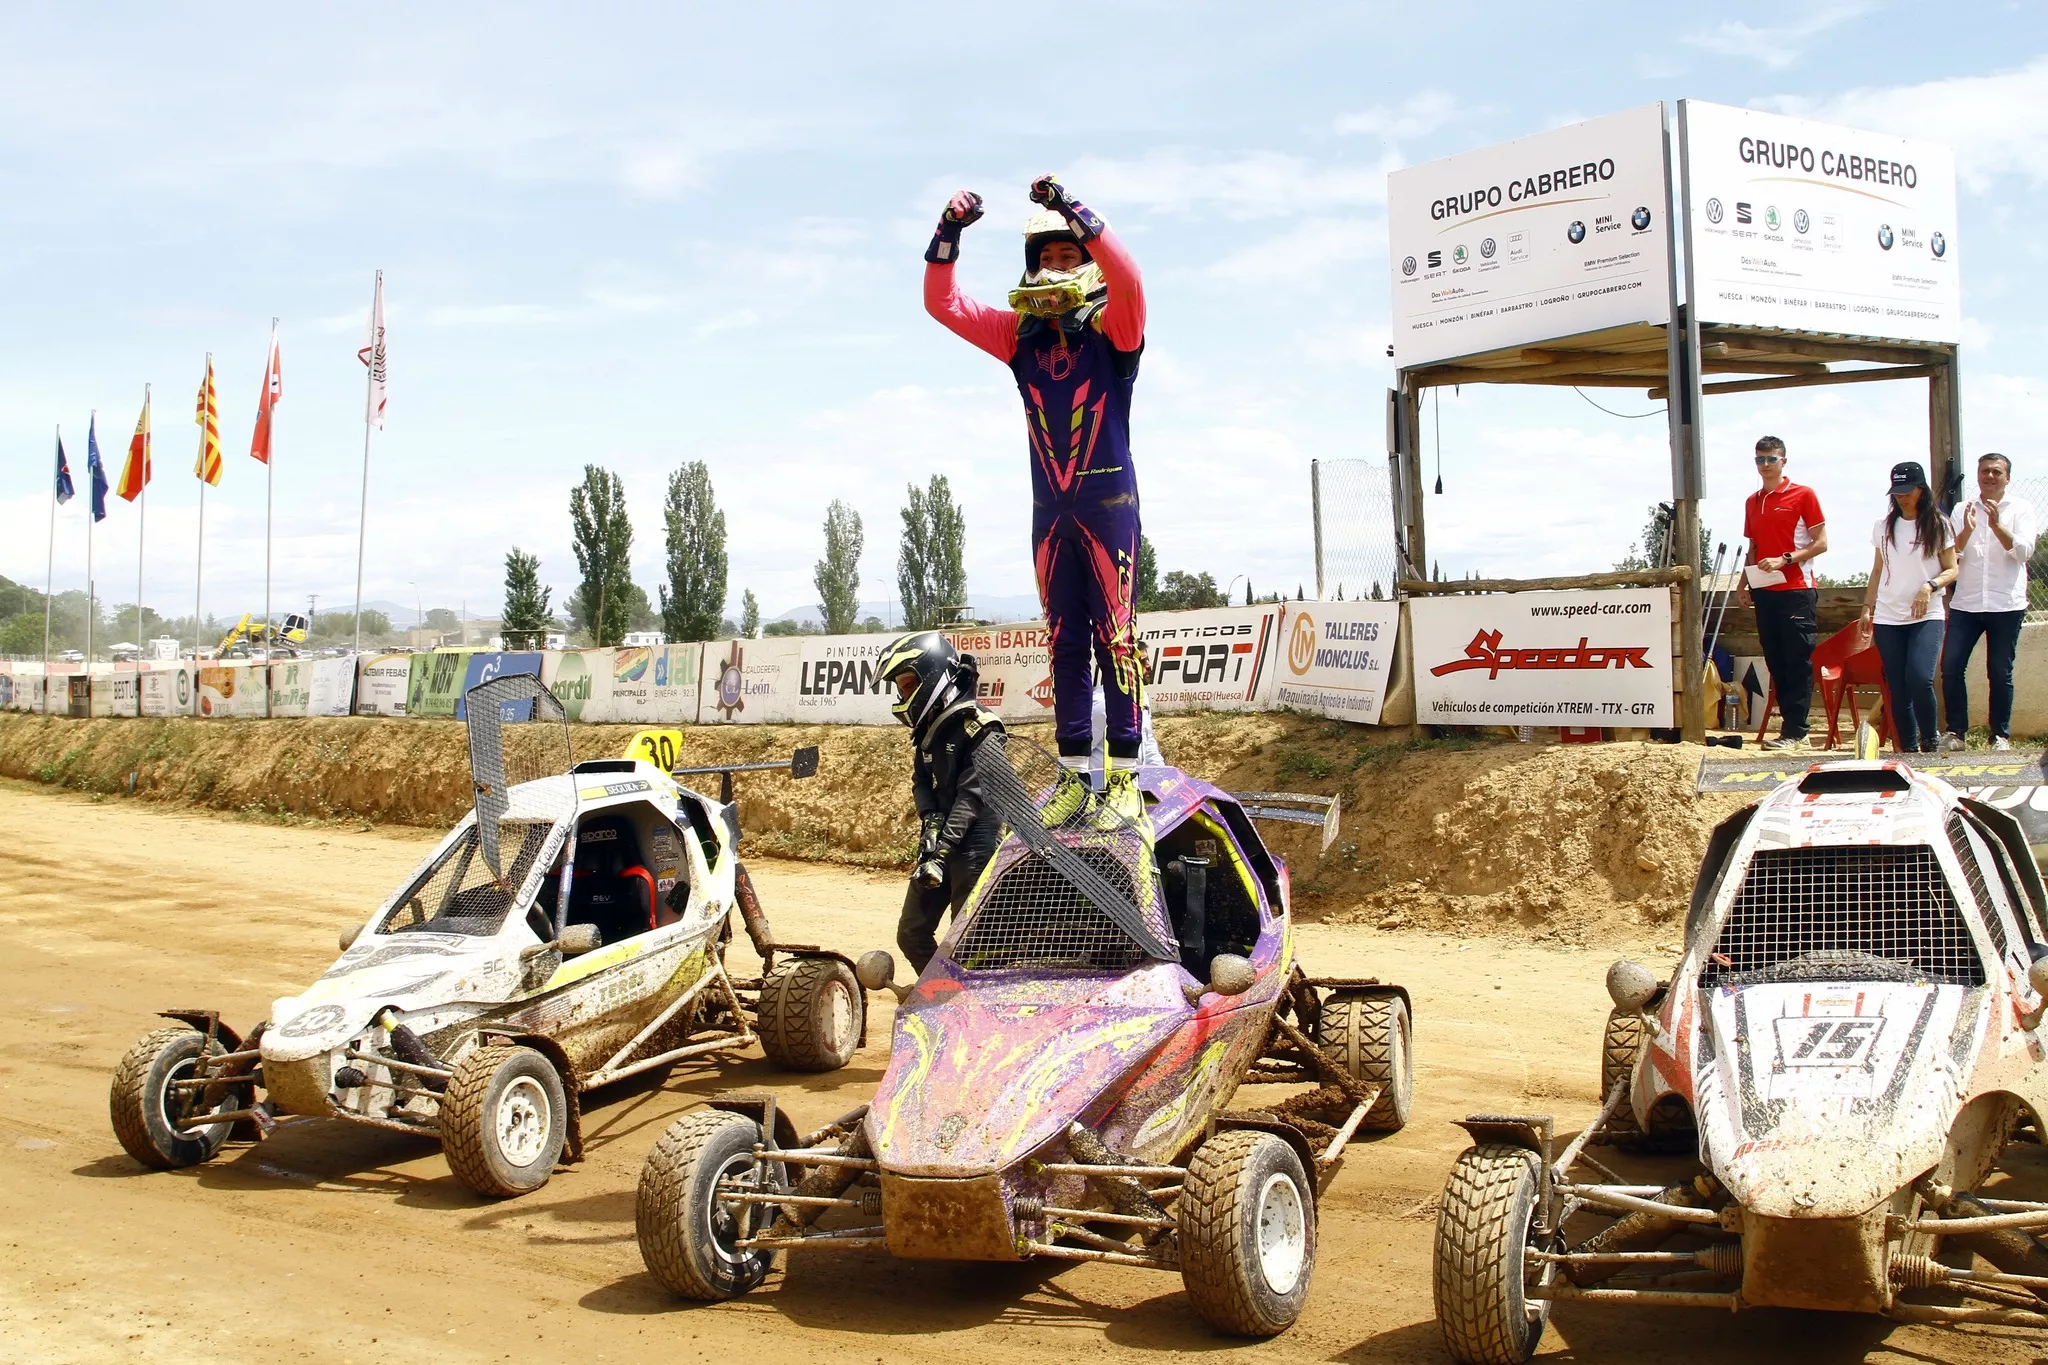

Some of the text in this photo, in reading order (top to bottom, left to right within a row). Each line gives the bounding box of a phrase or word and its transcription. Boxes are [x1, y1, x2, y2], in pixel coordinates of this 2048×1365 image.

[1739, 137, 1917, 189] GRUPO CABRERO
[1431, 158, 1615, 220] GRUPO CABRERO
[1595, 215, 1613, 225] MINI
[1595, 222, 1622, 234] Service
[1732, 229, 1759, 238] SEAT
[1901, 228, 1916, 238] MINI
[1901, 238, 1923, 249] Service
[1510, 248, 1523, 256] Audi
[1423, 270, 1448, 280] SEAT
[1412, 281, 1642, 330] HUESCA MONZÓN BINÉFAR BARBASTRO LOGROÑO GRUPOCABRERO.COM
[1719, 292, 1940, 320] HUESCA MONZÓN BINÉFAR BARBASTRO LOGROÑO GRUPOCABRERO.COM
[1531, 601, 1652, 618] www.speed-car.com
[1325, 622, 1379, 641] TALLERES
[942, 633, 991, 651] alleres
[826, 645, 880, 658] PINTURAS
[1315, 648, 1370, 670] MONCLUS
[385, 668, 407, 678] FEBAS
[744, 678, 770, 695] León
[612, 689, 647, 698] PRINCIPALES
[1155, 690, 1245, 702] 22510 BINACED (Huesca)
[1277, 687, 1318, 706] Maquinaria
[1345, 695, 1374, 712] Industrial
[799, 696, 837, 707] desde 1965
[1432, 700, 1477, 714] Vehículos
[1478, 701, 1492, 713] de
[1493, 701, 1555, 719] competición
[1556, 702, 1593, 714] XTREM
[1601, 703, 1622, 714] TTX
[1631, 703, 1655, 715] GTR
[641, 735, 675, 772] 30
[606, 782, 639, 795] SEGURA
[581, 829, 617, 840] sparco
